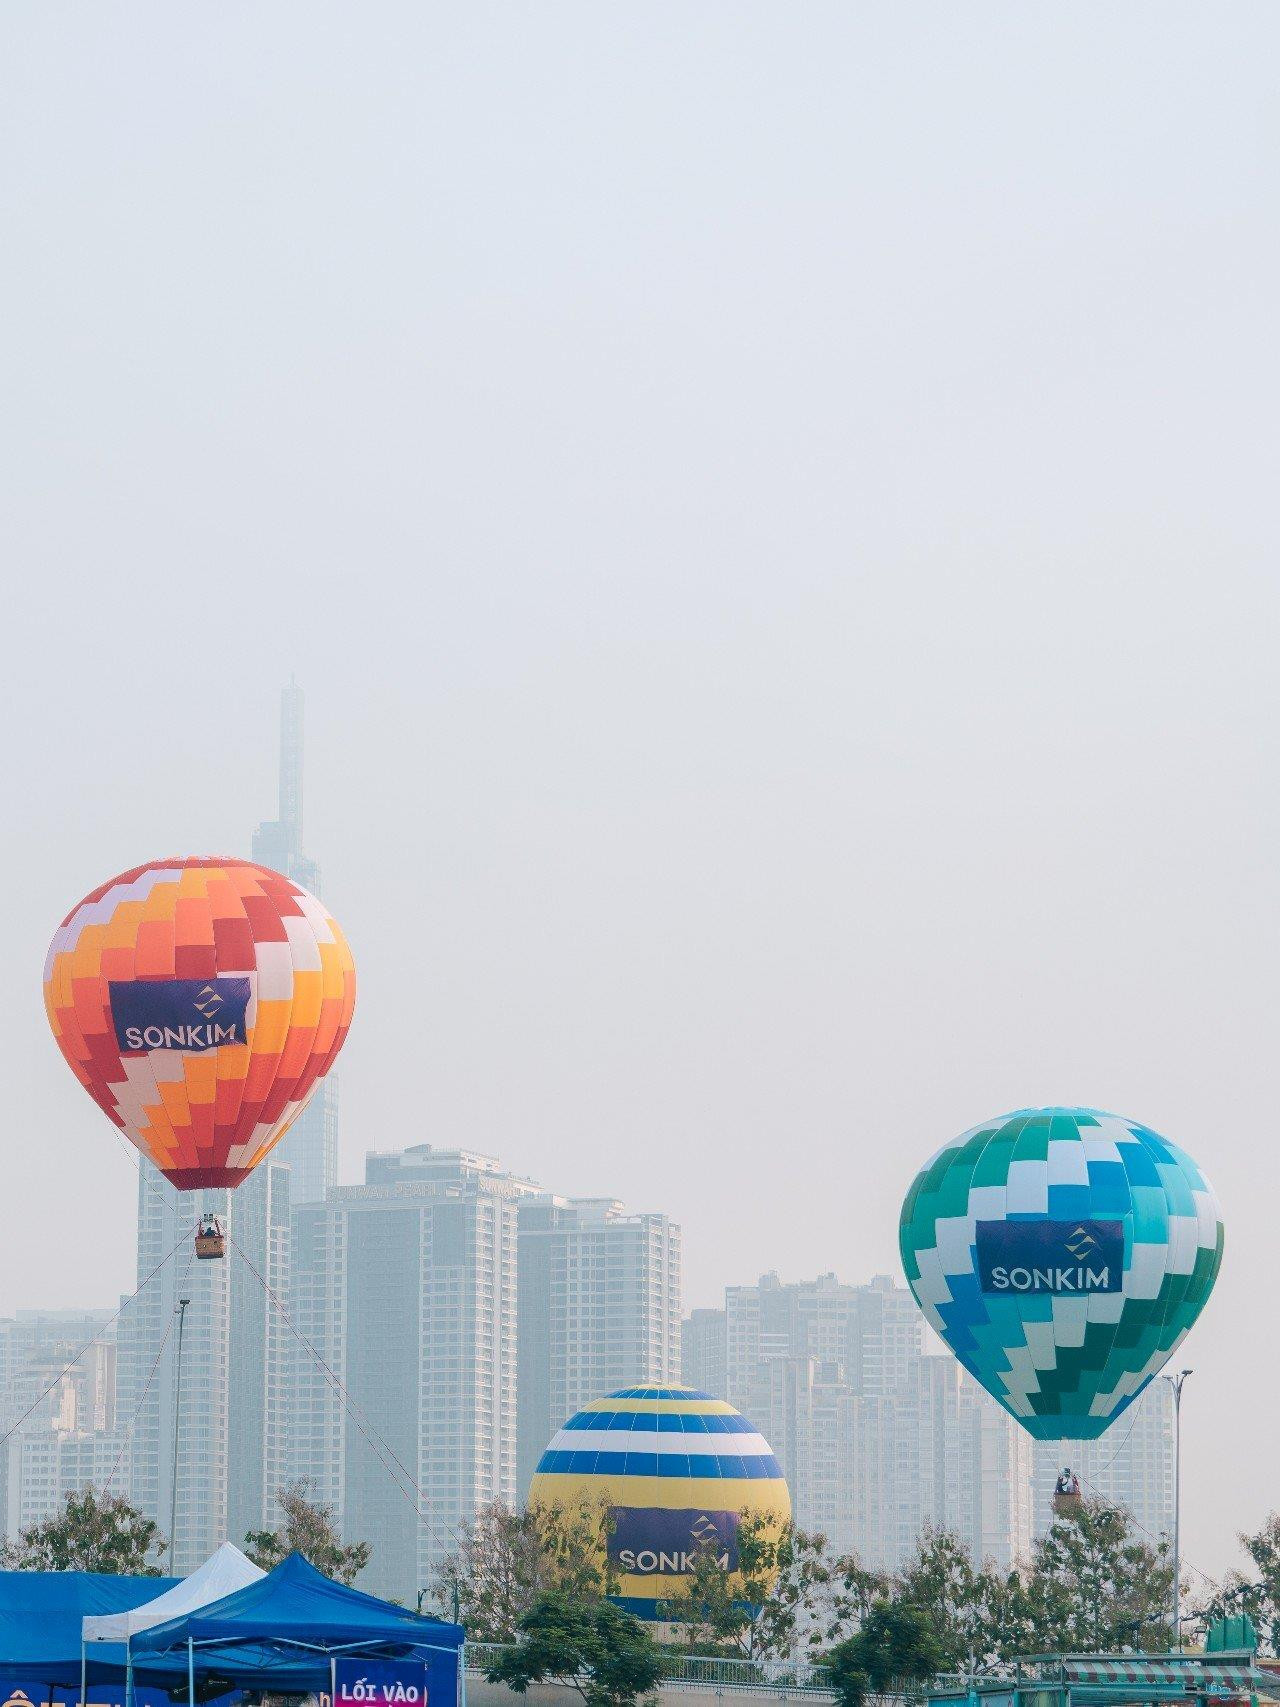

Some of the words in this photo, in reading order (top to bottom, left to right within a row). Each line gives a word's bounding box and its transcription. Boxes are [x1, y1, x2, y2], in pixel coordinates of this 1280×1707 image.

[125, 1023, 236, 1048] SONKIM
[991, 1266, 1109, 1290] SONKIM
[620, 1550, 729, 1572] SONKM
[341, 1677, 376, 1701] LỐI
[383, 1681, 418, 1702] VÀO
